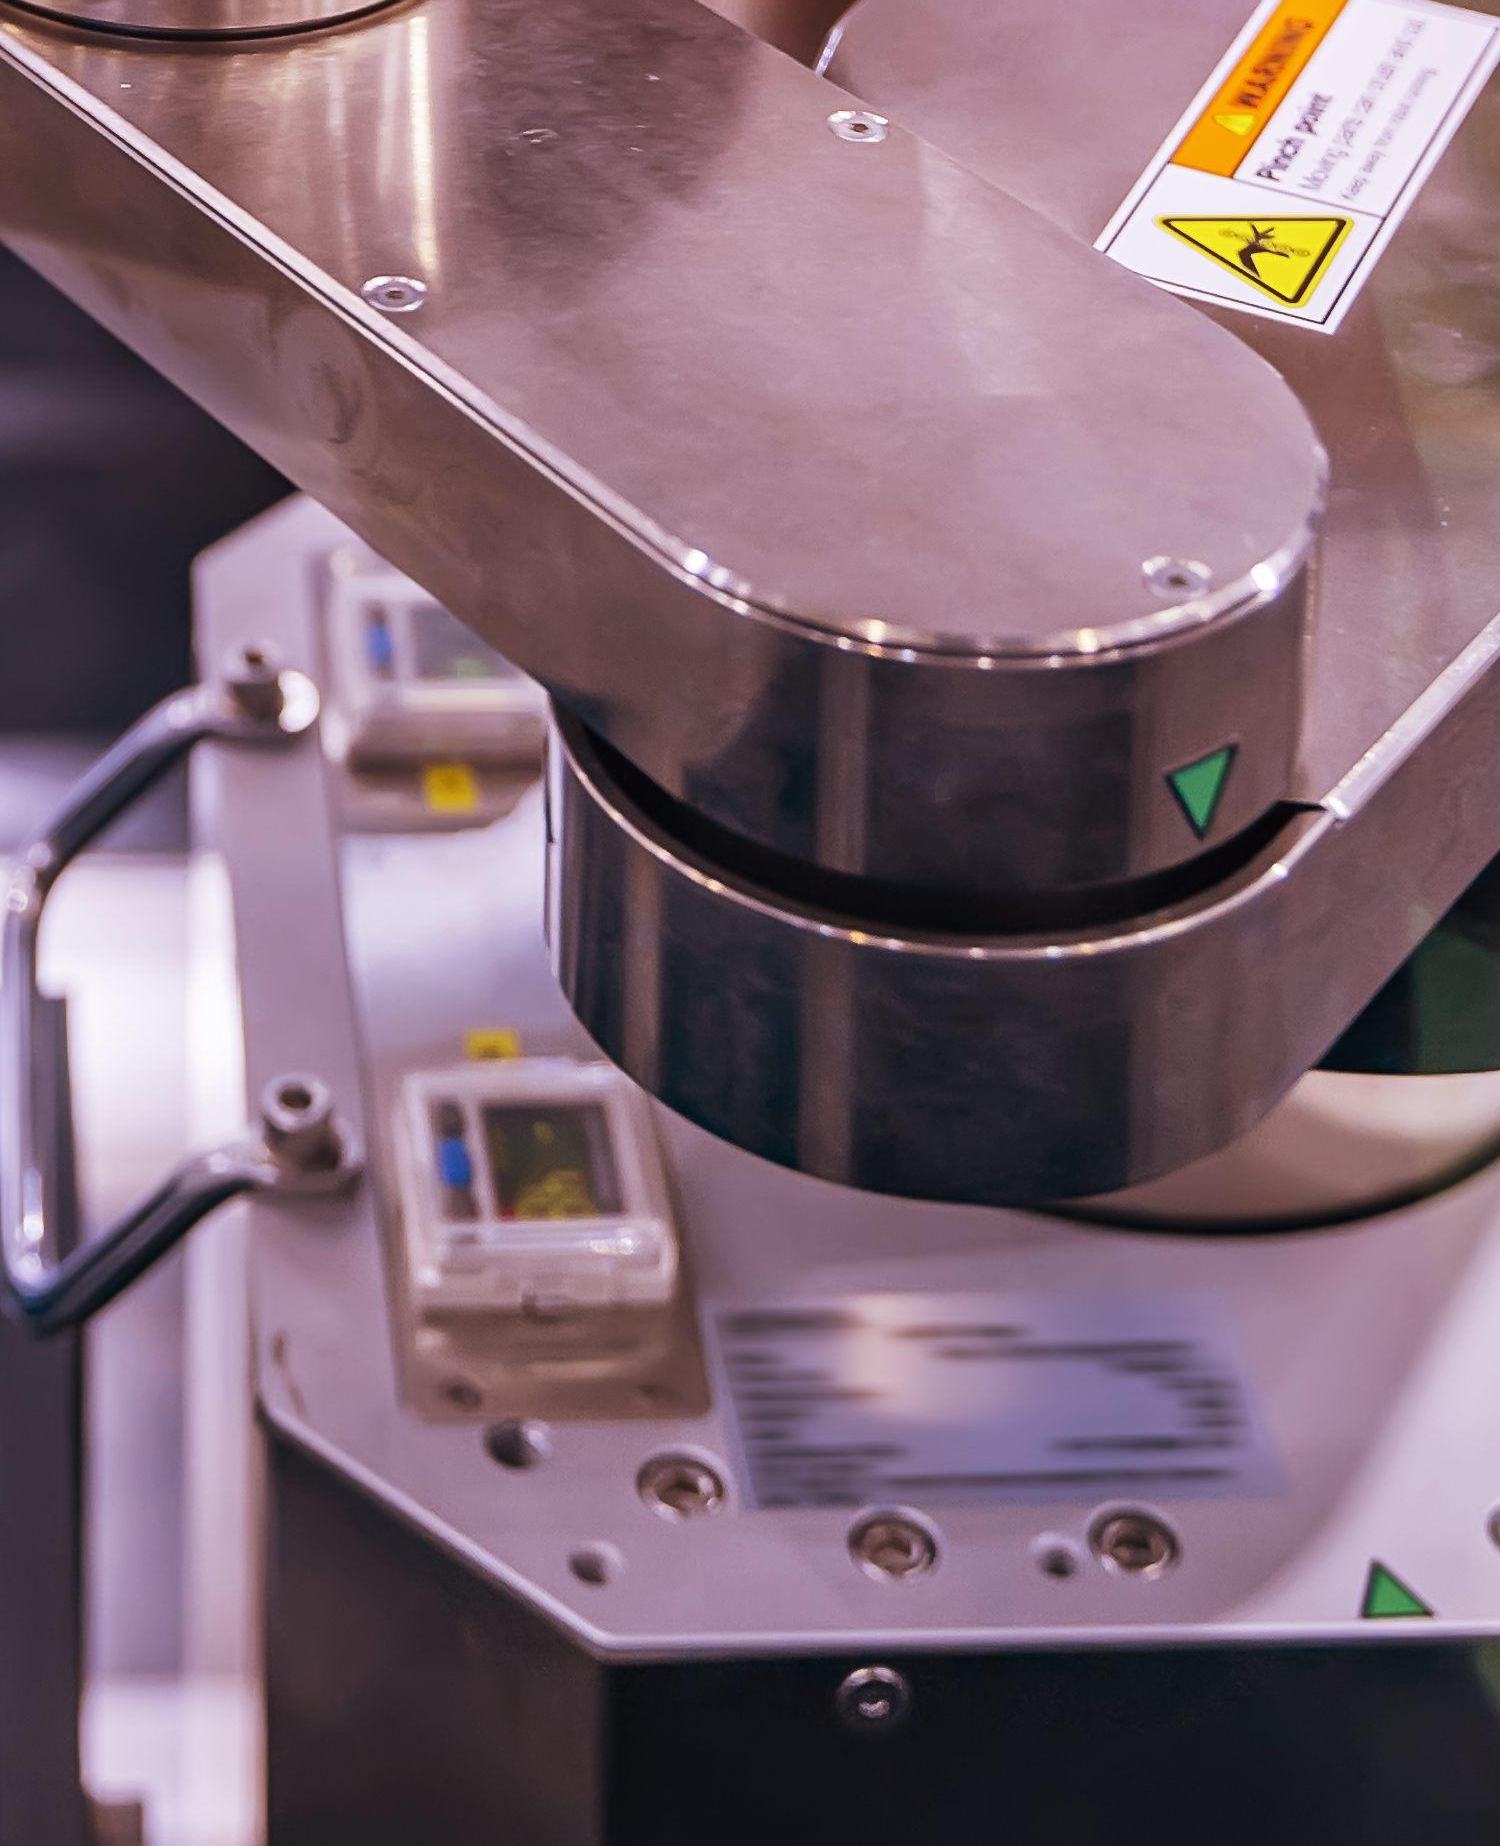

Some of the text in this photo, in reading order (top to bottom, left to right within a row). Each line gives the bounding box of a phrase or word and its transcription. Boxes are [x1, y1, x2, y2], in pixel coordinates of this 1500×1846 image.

[1233, 16, 1315, 109] WARNING
[1254, 91, 1337, 182] Pinch point
[1298, 147, 1350, 193] Moving
